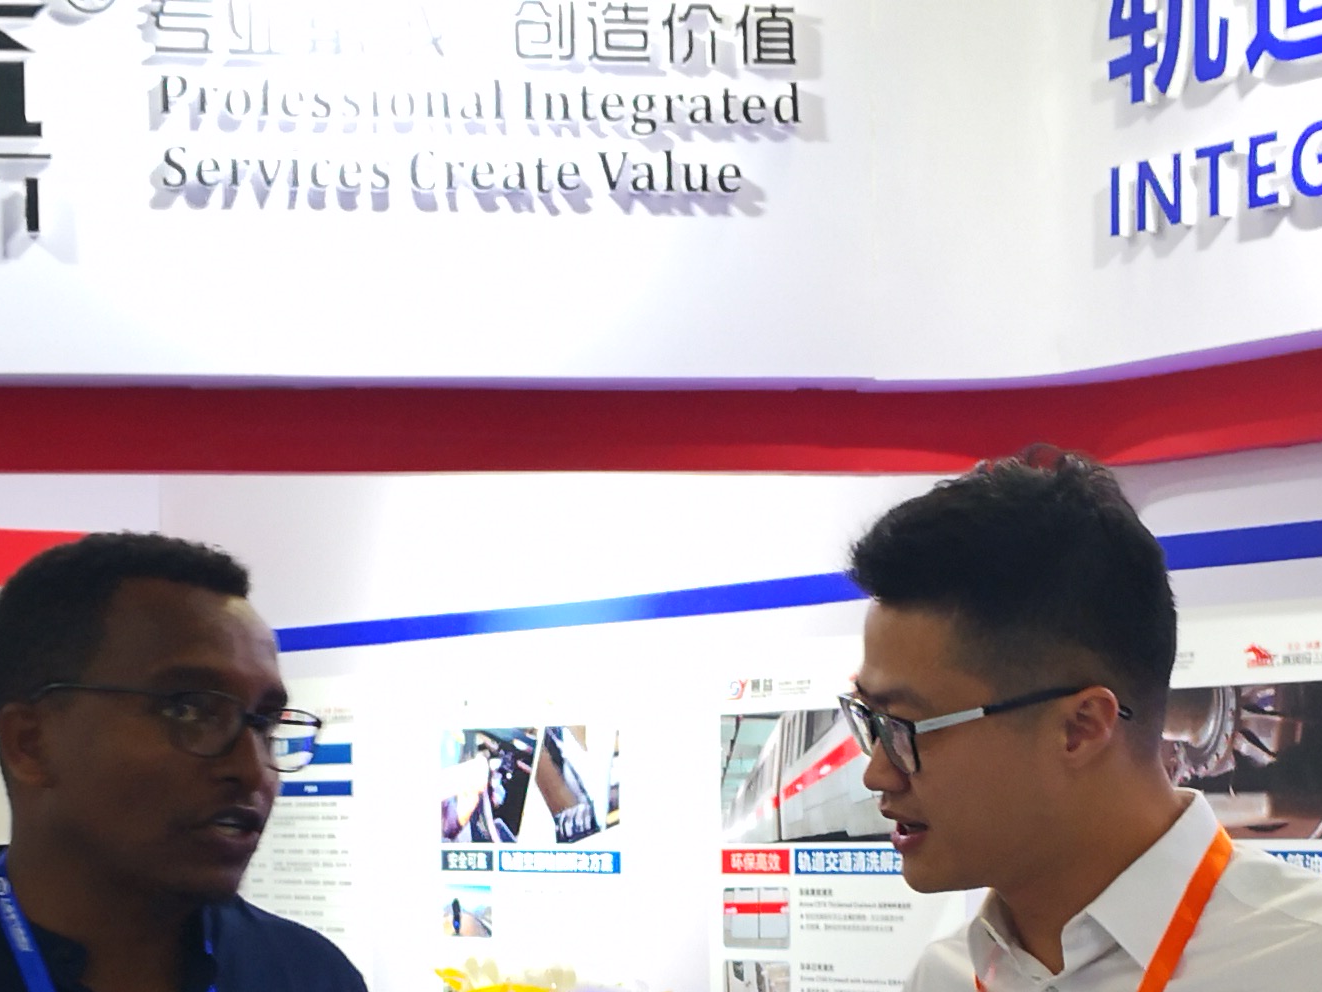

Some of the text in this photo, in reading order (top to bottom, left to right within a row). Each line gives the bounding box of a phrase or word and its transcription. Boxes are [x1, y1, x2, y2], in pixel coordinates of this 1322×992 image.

[158, 74, 803, 136] Professional Integrated
[160, 146, 743, 193] Services Create Value
[730, 851, 782, 872] 环保高效
